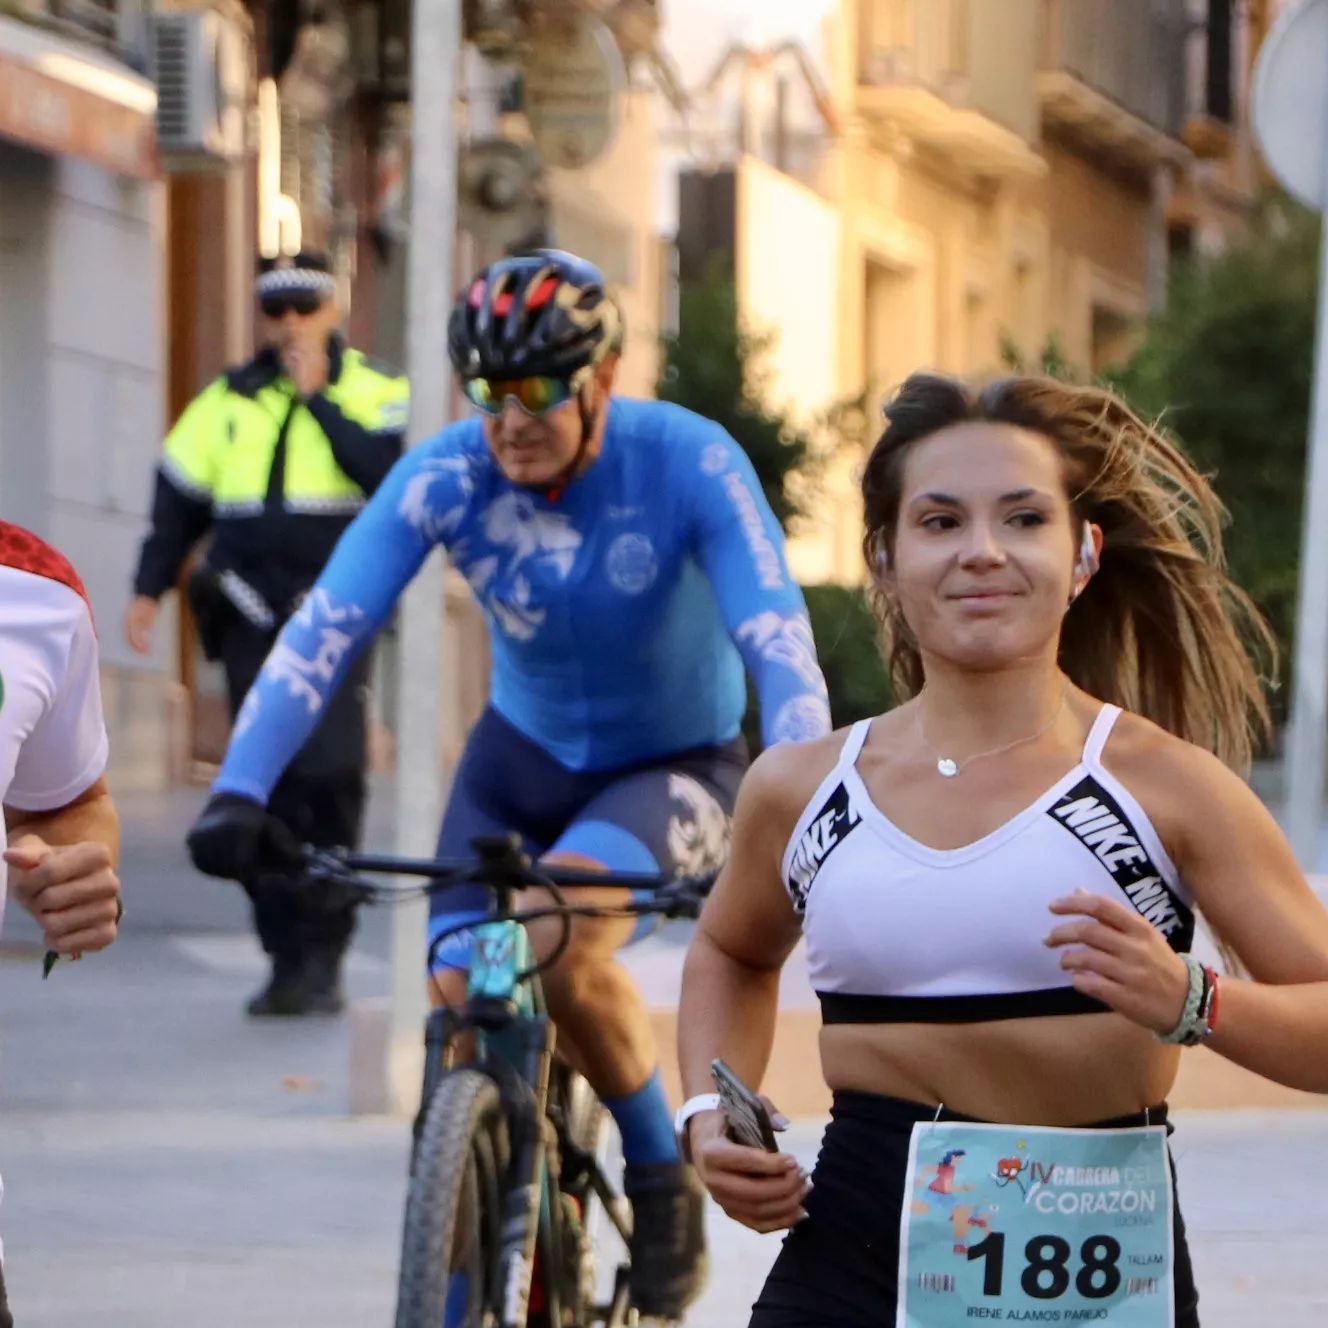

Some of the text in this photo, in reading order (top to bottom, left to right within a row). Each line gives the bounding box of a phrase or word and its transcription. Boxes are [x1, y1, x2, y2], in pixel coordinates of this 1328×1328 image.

[1054, 796, 1148, 873] NIKE
[1030, 1162, 1054, 1184] IV
[967, 1233, 1121, 1299] 188
[967, 1307, 1108, 1320] IRENE ALAMOS PAREJO
